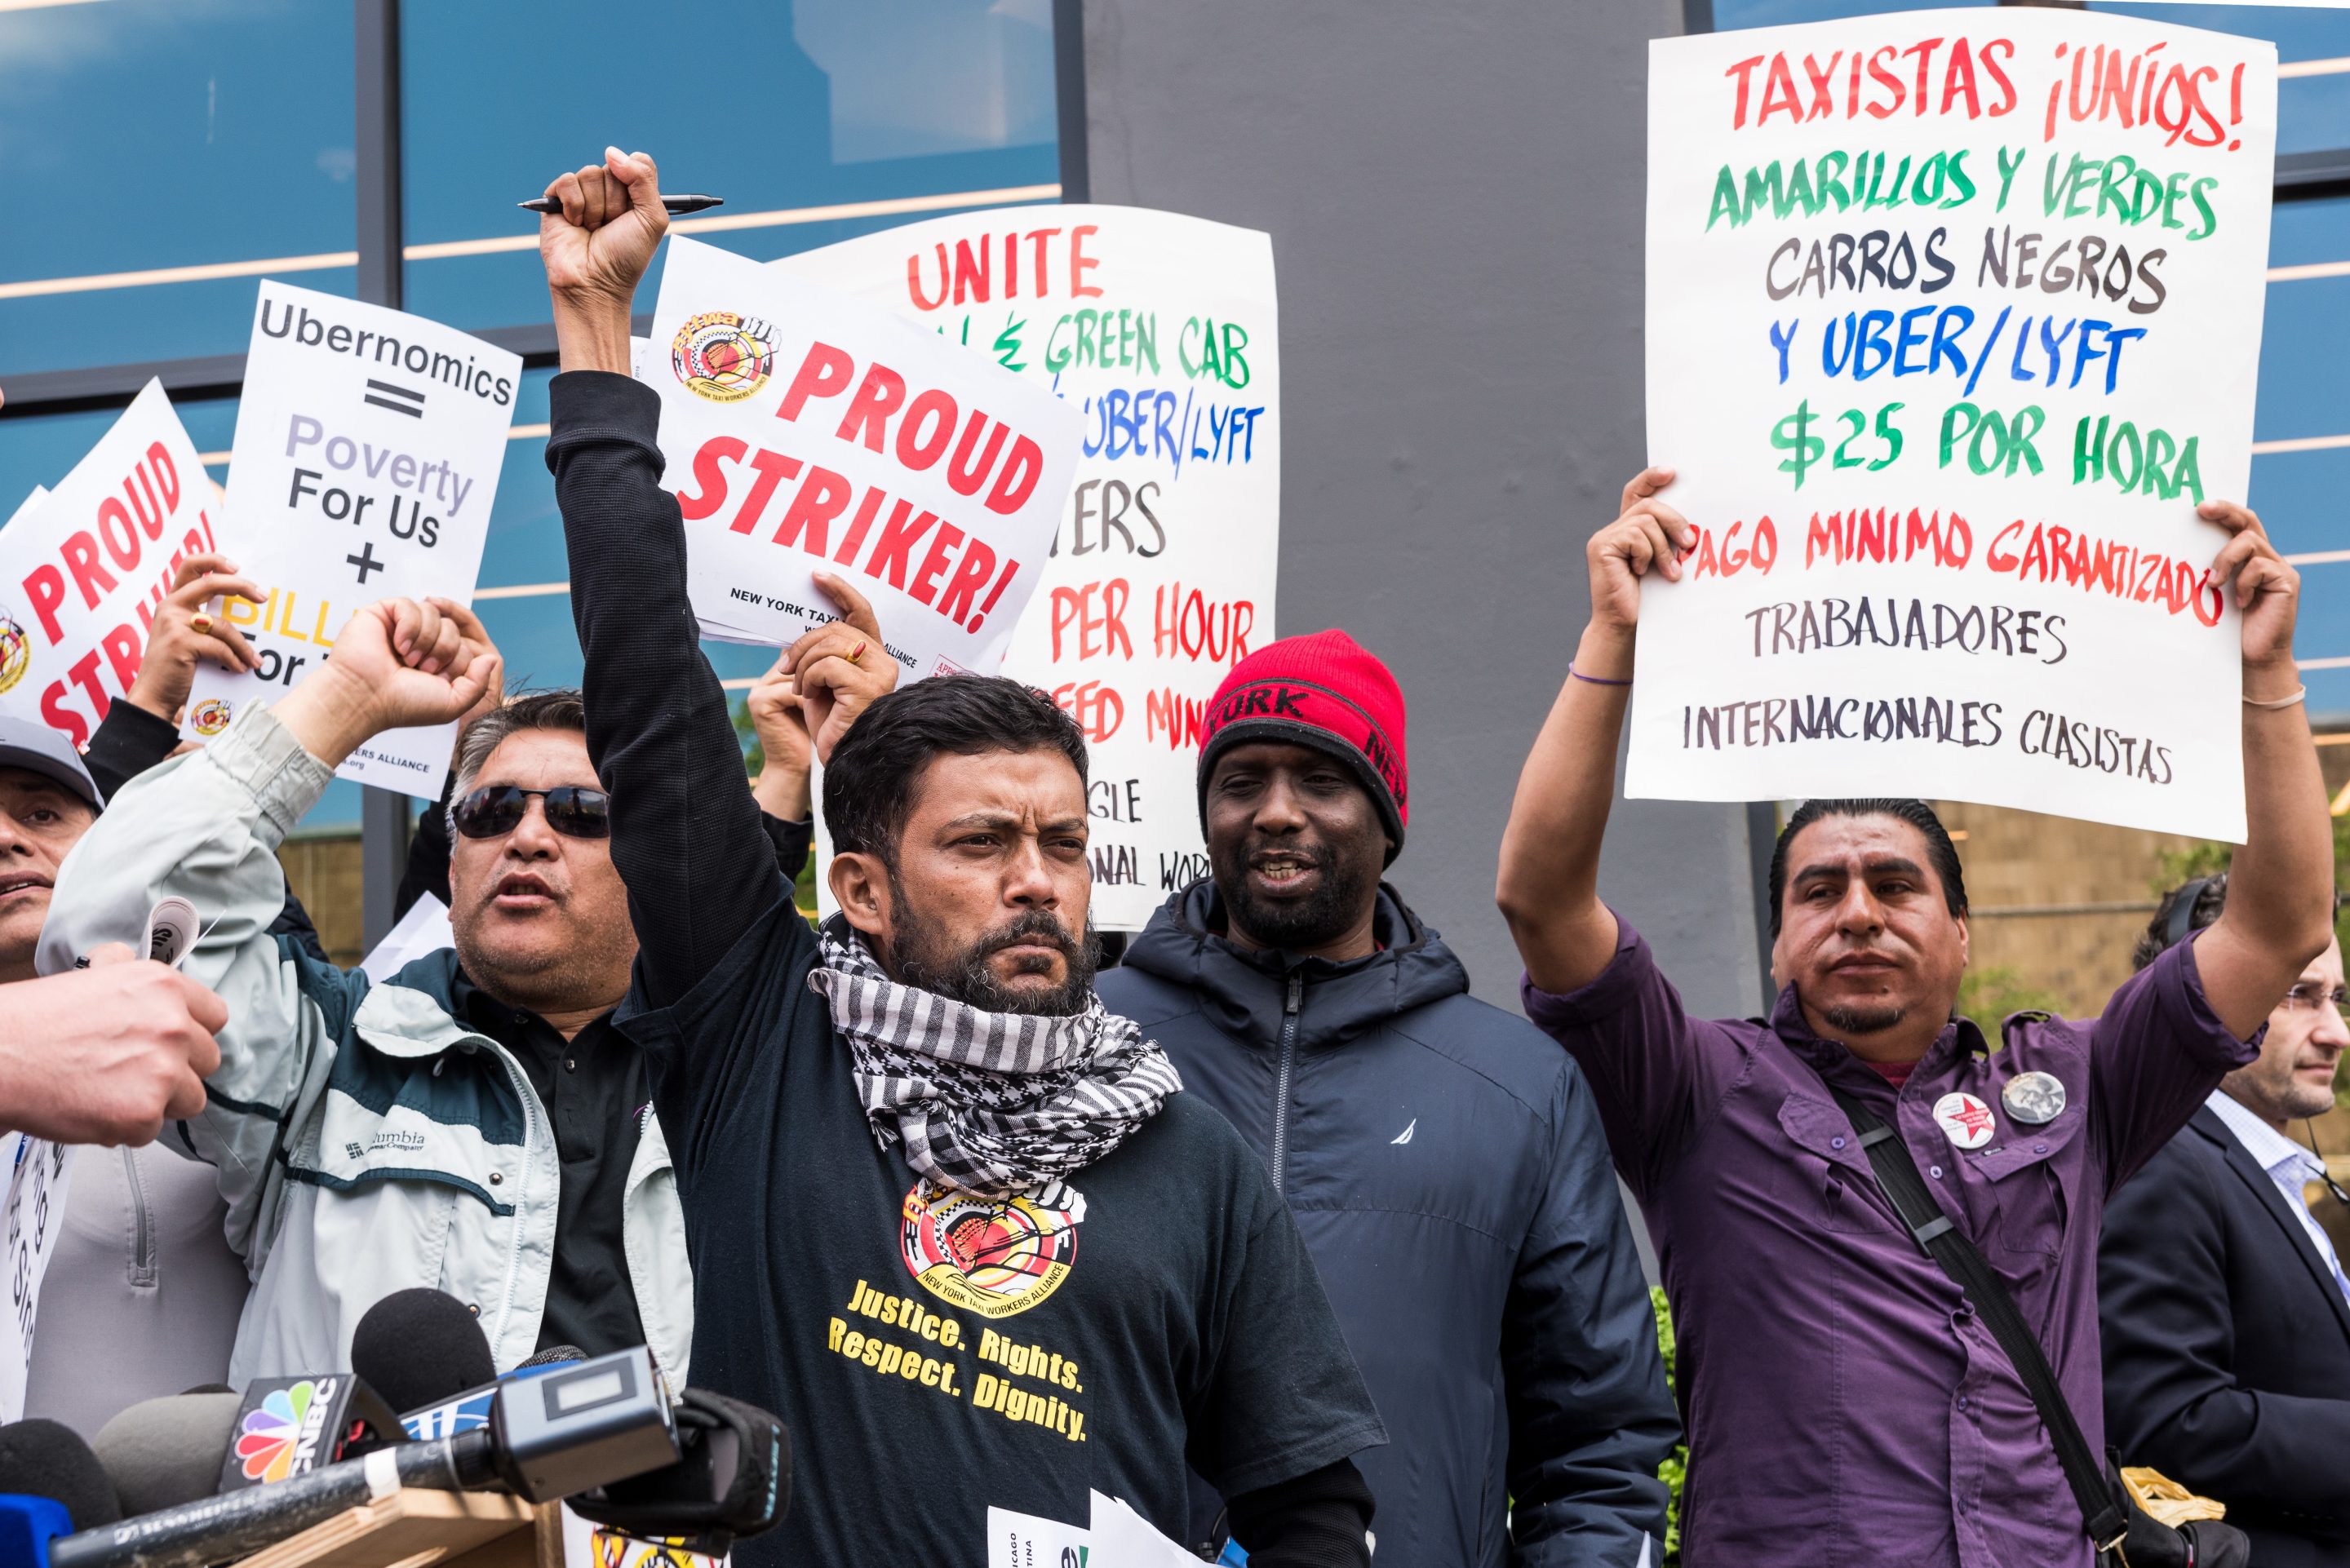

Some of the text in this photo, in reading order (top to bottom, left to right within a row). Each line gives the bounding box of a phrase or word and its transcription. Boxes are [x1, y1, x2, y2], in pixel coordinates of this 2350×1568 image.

[1725, 37, 2018, 131] TAXISTAS
[1705, 144, 2219, 241] AMARILLOS Y VERDES
[907, 225, 1104, 311] UNITE
[1767, 224, 2167, 315] CARROS NEGROS
[260, 298, 512, 406] Ubernomics
[1045, 308, 1160, 377] GREEN
[1178, 315, 1250, 389] CAB
[1770, 304, 2148, 396] Y UBER/LYFT
[725, 391, 750, 402] WORKERS
[775, 340, 1044, 515] PROUD
[285, 414, 473, 517] Poverty
[1770, 399, 2205, 507] $25 POR HORA
[22, 441, 180, 647] PROUD
[288, 467, 441, 548] For Us
[676, 436, 1021, 636] STRIKER!
[1049, 479, 1165, 558] ERS
[1806, 506, 1974, 572] MINIMO
[730, 587, 840, 626] NEW YORK TAX
[1049, 578, 1254, 668] PER HOUR
[1745, 596, 2067, 665] TRABAJADORES
[377, 753, 431, 773] ALLIANCE
[1683, 694, 2172, 785] INTERNACIONALES CLASISTAS
[1087, 844, 1146, 886] NAL
[923, 1264, 1065, 1315] NEW YORK TAXI WORKERS ALLIANCE
[828, 1316, 1087, 1442] Respect. Dignity.
[847, 1278, 1084, 1393] Justice. Rights.
